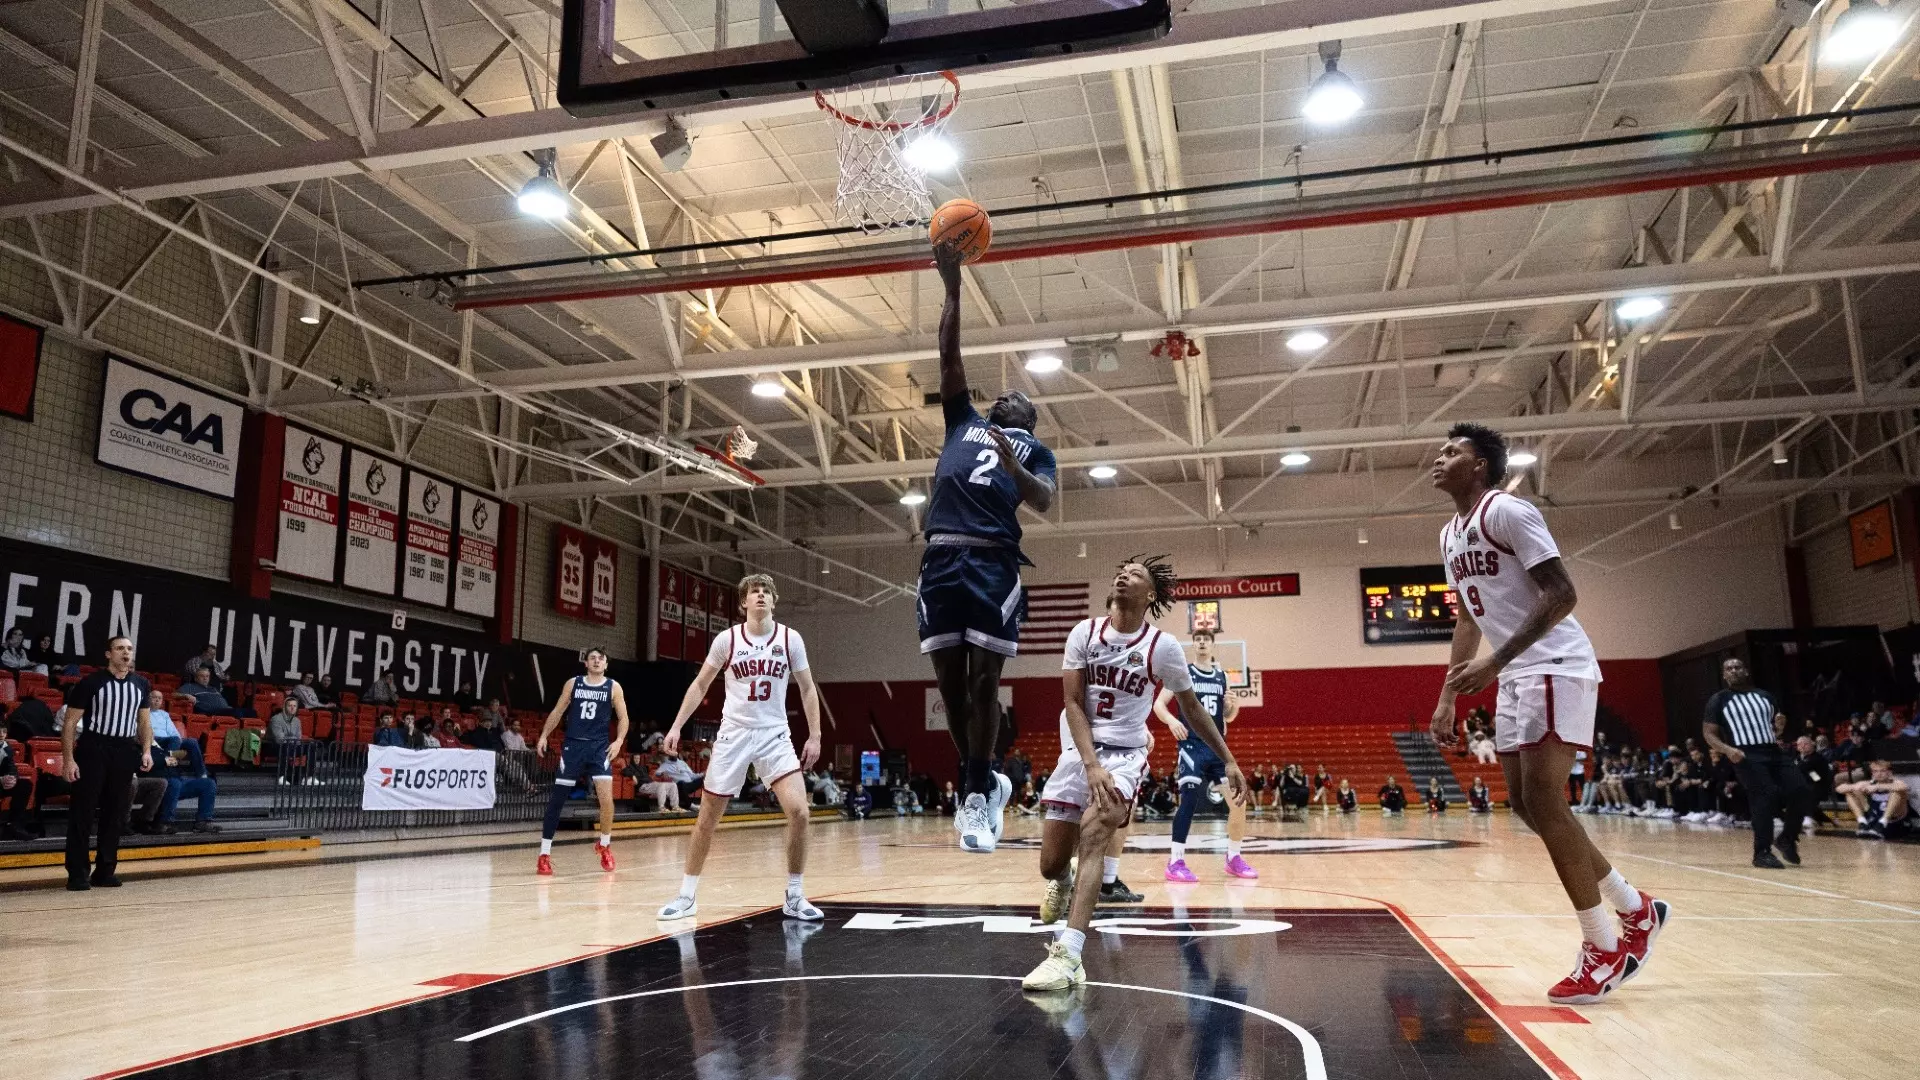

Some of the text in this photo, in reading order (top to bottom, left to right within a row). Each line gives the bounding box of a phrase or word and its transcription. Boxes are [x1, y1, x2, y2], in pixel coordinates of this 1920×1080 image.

[120, 388, 224, 454] CAA
[110, 429, 230, 471] COASTAL ATHLETIC ASSOCIATION
[968, 449, 999, 486] 2
[293, 485, 327, 510] NCAA
[283, 499, 335, 523] TOURNAMENT
[286, 518, 305, 533] 1999
[349, 519, 394, 540] CHAMPIONS
[350, 536, 369, 550] 2023
[410, 552, 425, 564] 1985
[1449, 550, 1499, 585] USKIES
[409, 566, 425, 578] 1987
[564, 564, 579, 586] 35
[597, 574, 609, 594] 10
[1238, 580, 1282, 593] Court
[1370, 596, 1383, 607] 35
[1444, 592, 1457, 604] 30
[1466, 585, 1485, 617] 9
[395, 616, 402, 628] C
[209, 607, 489, 700] UNIVERSITY
[731, 659, 787, 680] HUSKIES
[1086, 663, 1149, 697] USKIES
[575, 688, 608, 702] MONMOUTH
[748, 680, 771, 701] 13
[580, 701, 597, 720] 13
[1096, 691, 1115, 720] 2
[1201, 695, 1218, 717] 15
[393, 768, 487, 789] FLOSPORTS
